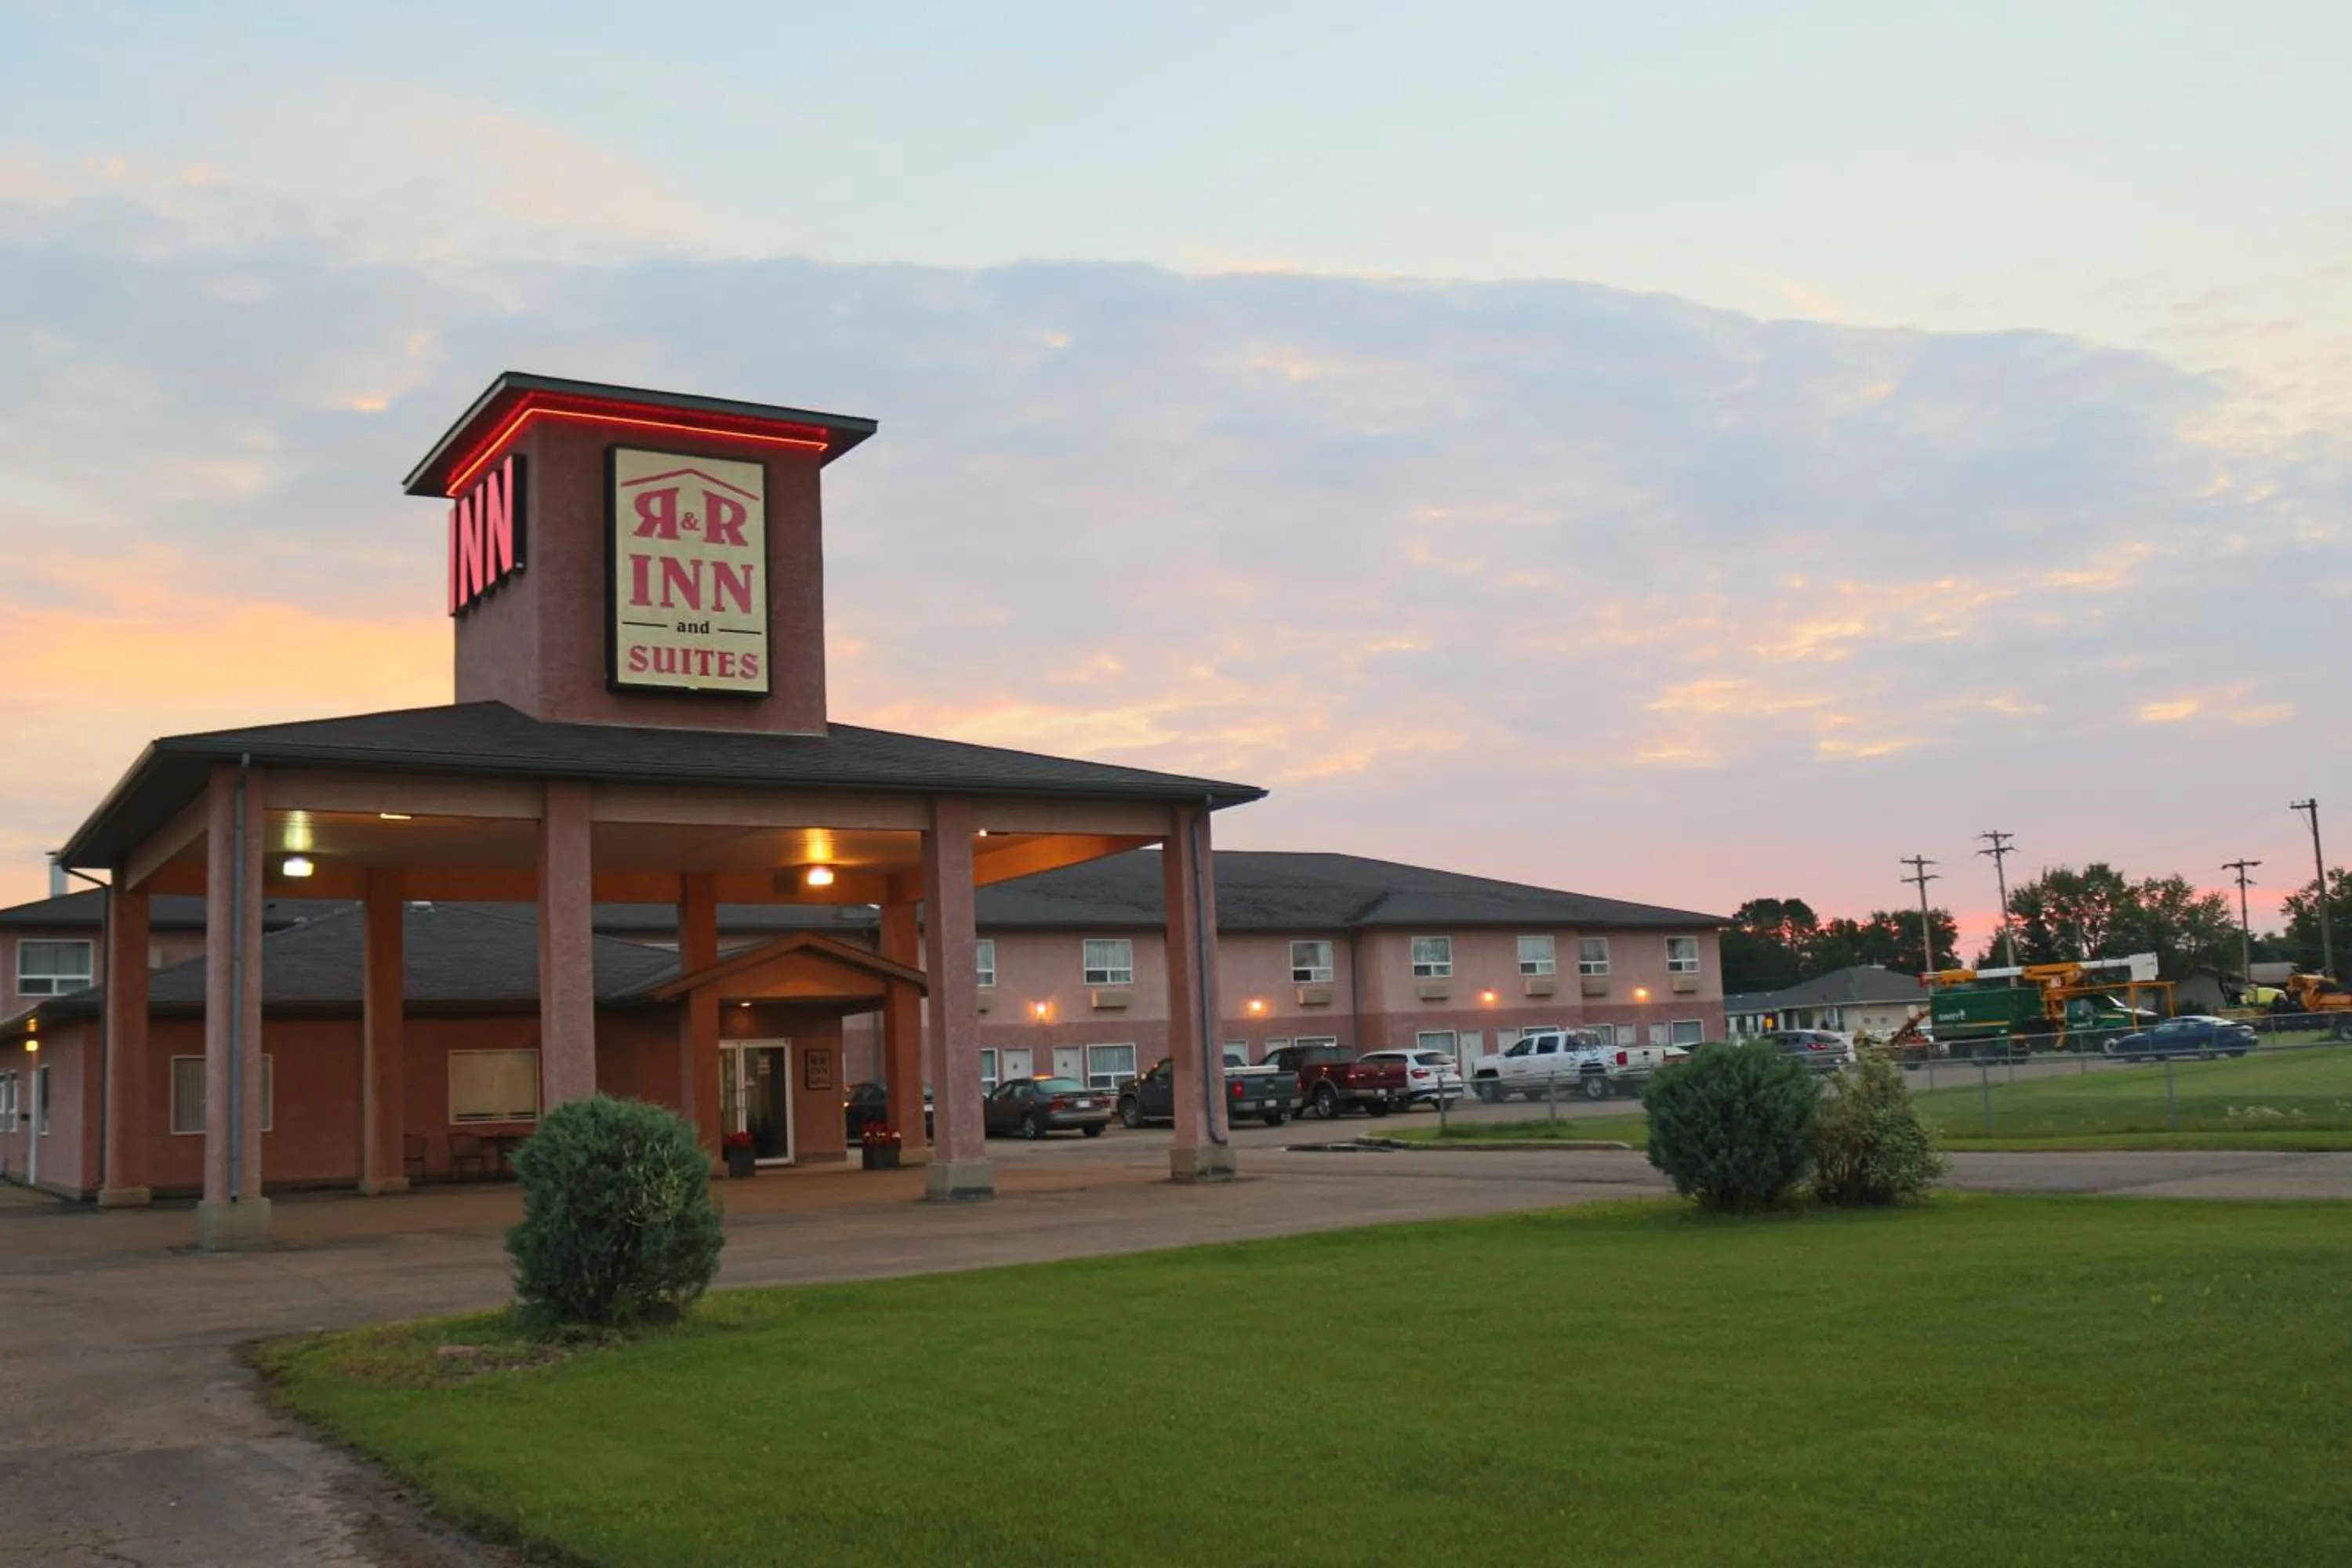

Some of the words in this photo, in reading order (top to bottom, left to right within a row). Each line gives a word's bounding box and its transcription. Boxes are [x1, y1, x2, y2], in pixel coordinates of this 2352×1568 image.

[448, 454, 513, 616] INN
[629, 554, 754, 615] INN
[677, 620, 710, 634] and
[627, 644, 760, 680] SUITES
